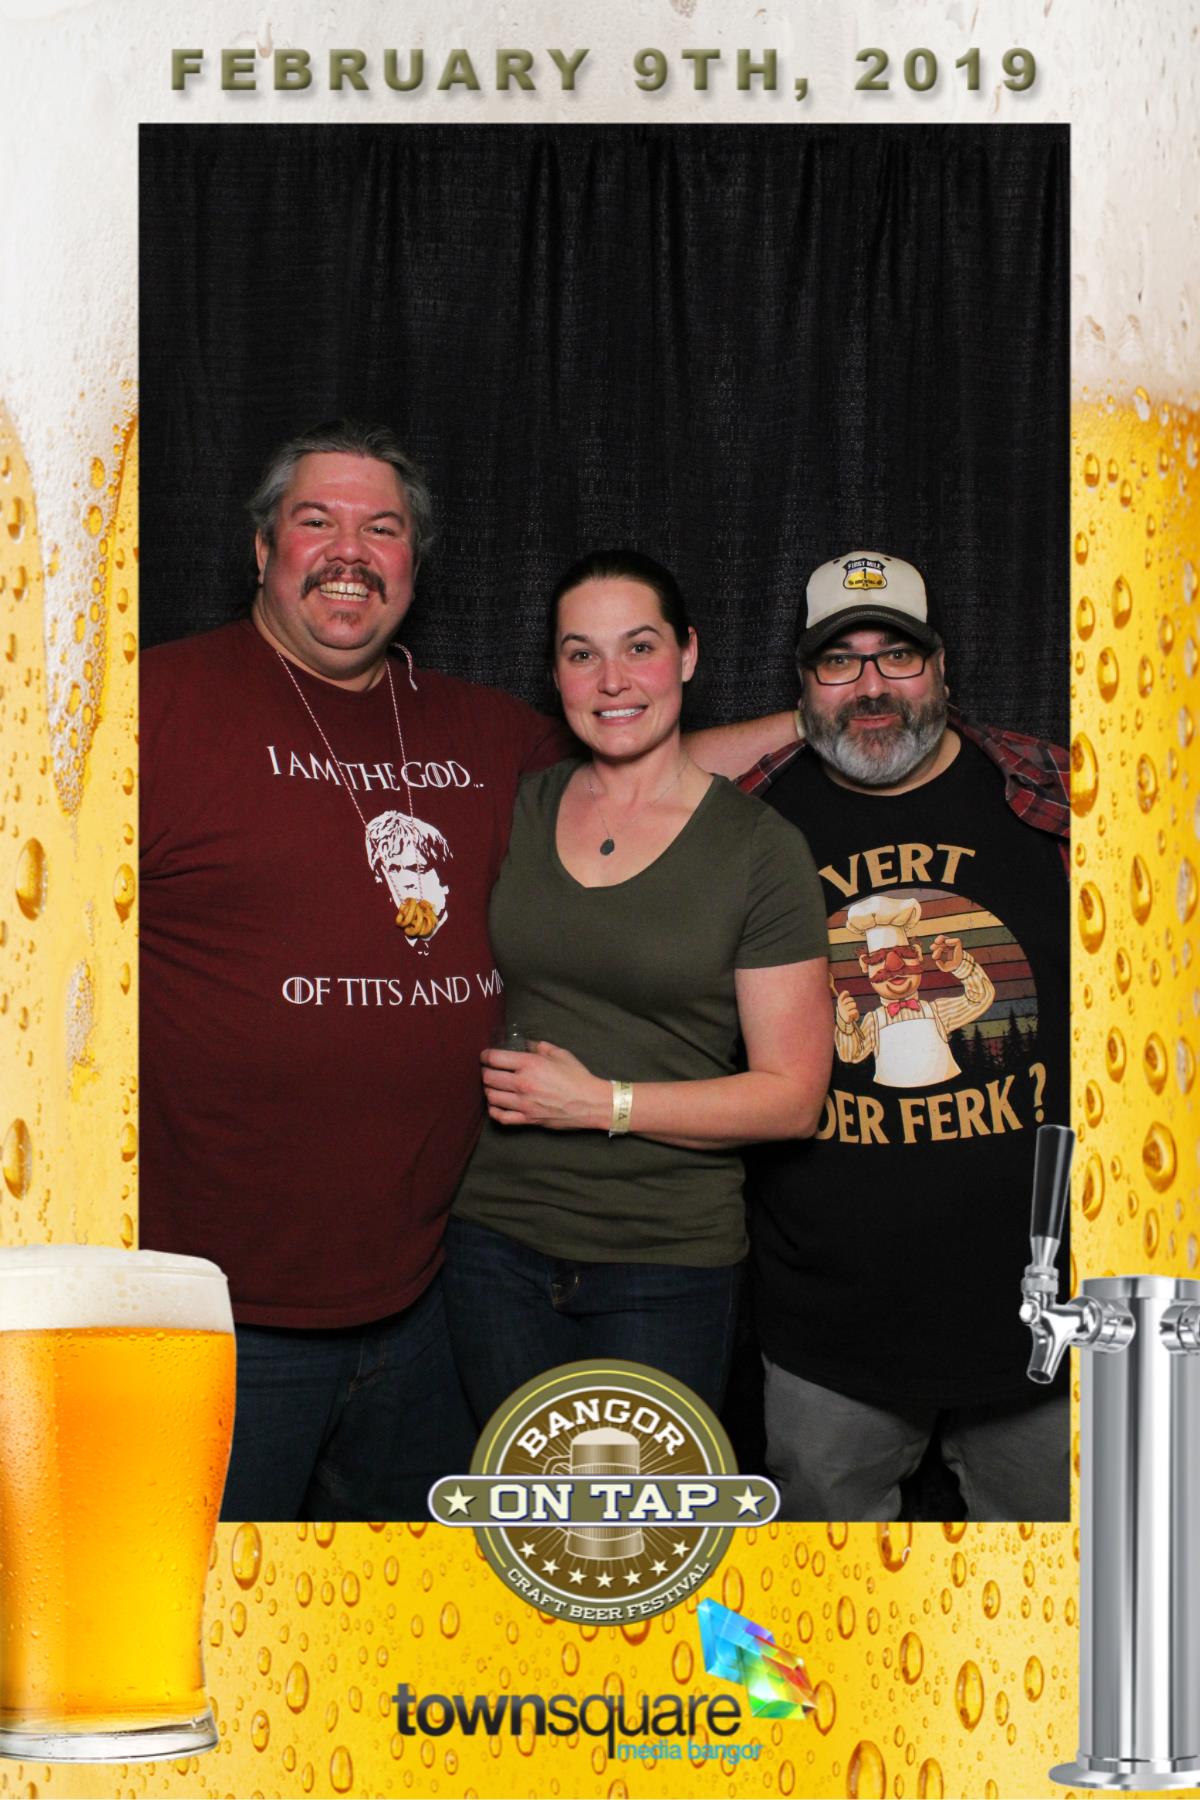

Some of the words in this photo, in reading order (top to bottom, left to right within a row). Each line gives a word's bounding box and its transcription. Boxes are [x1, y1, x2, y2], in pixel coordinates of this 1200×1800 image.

[267, 745, 282, 775] I
[289, 751, 341, 786] AM
[338, 761, 401, 791] THE
[818, 842, 976, 898] VERT
[281, 976, 331, 1005] OF
[337, 977, 403, 1006] TITS
[410, 975, 471, 1006] AND
